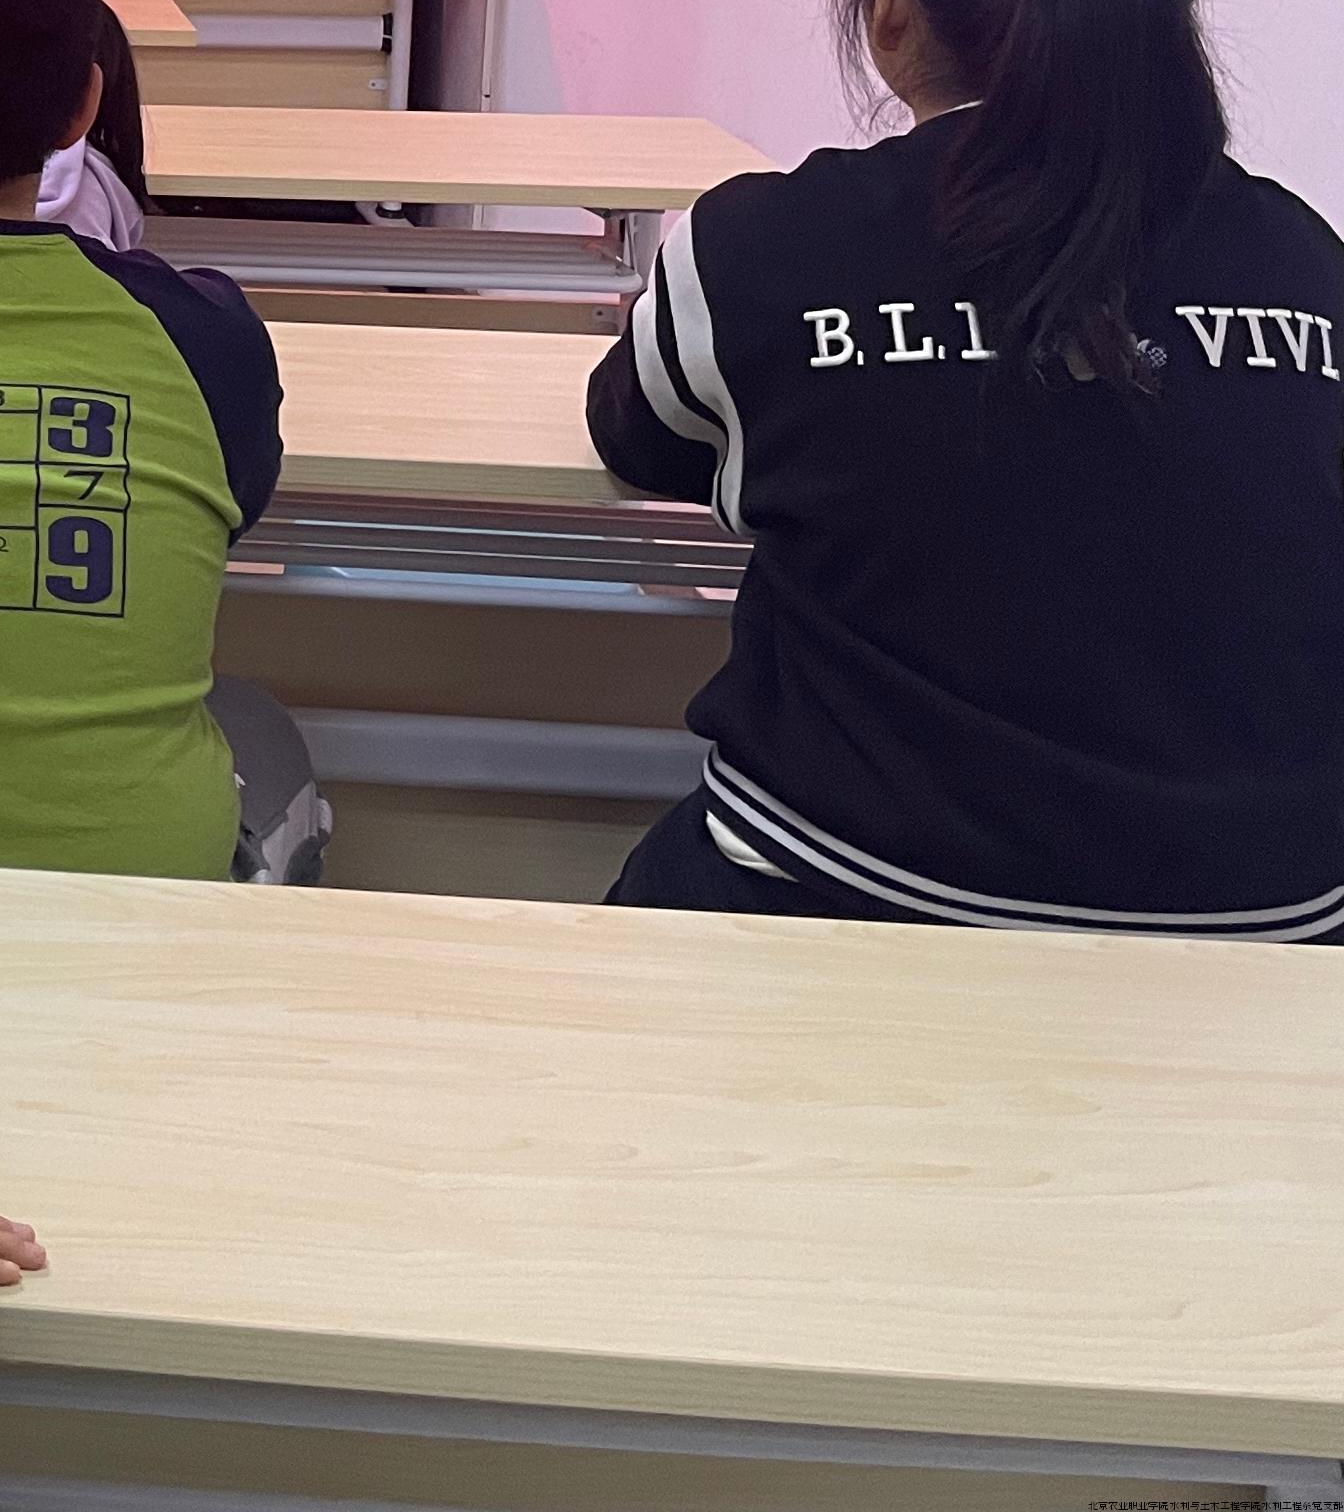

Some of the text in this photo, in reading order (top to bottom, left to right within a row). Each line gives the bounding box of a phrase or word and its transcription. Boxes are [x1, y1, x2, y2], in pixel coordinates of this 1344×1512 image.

[47, 395, 117, 459] 3
[50, 469, 105, 502] 7
[44, 515, 114, 604] 9
